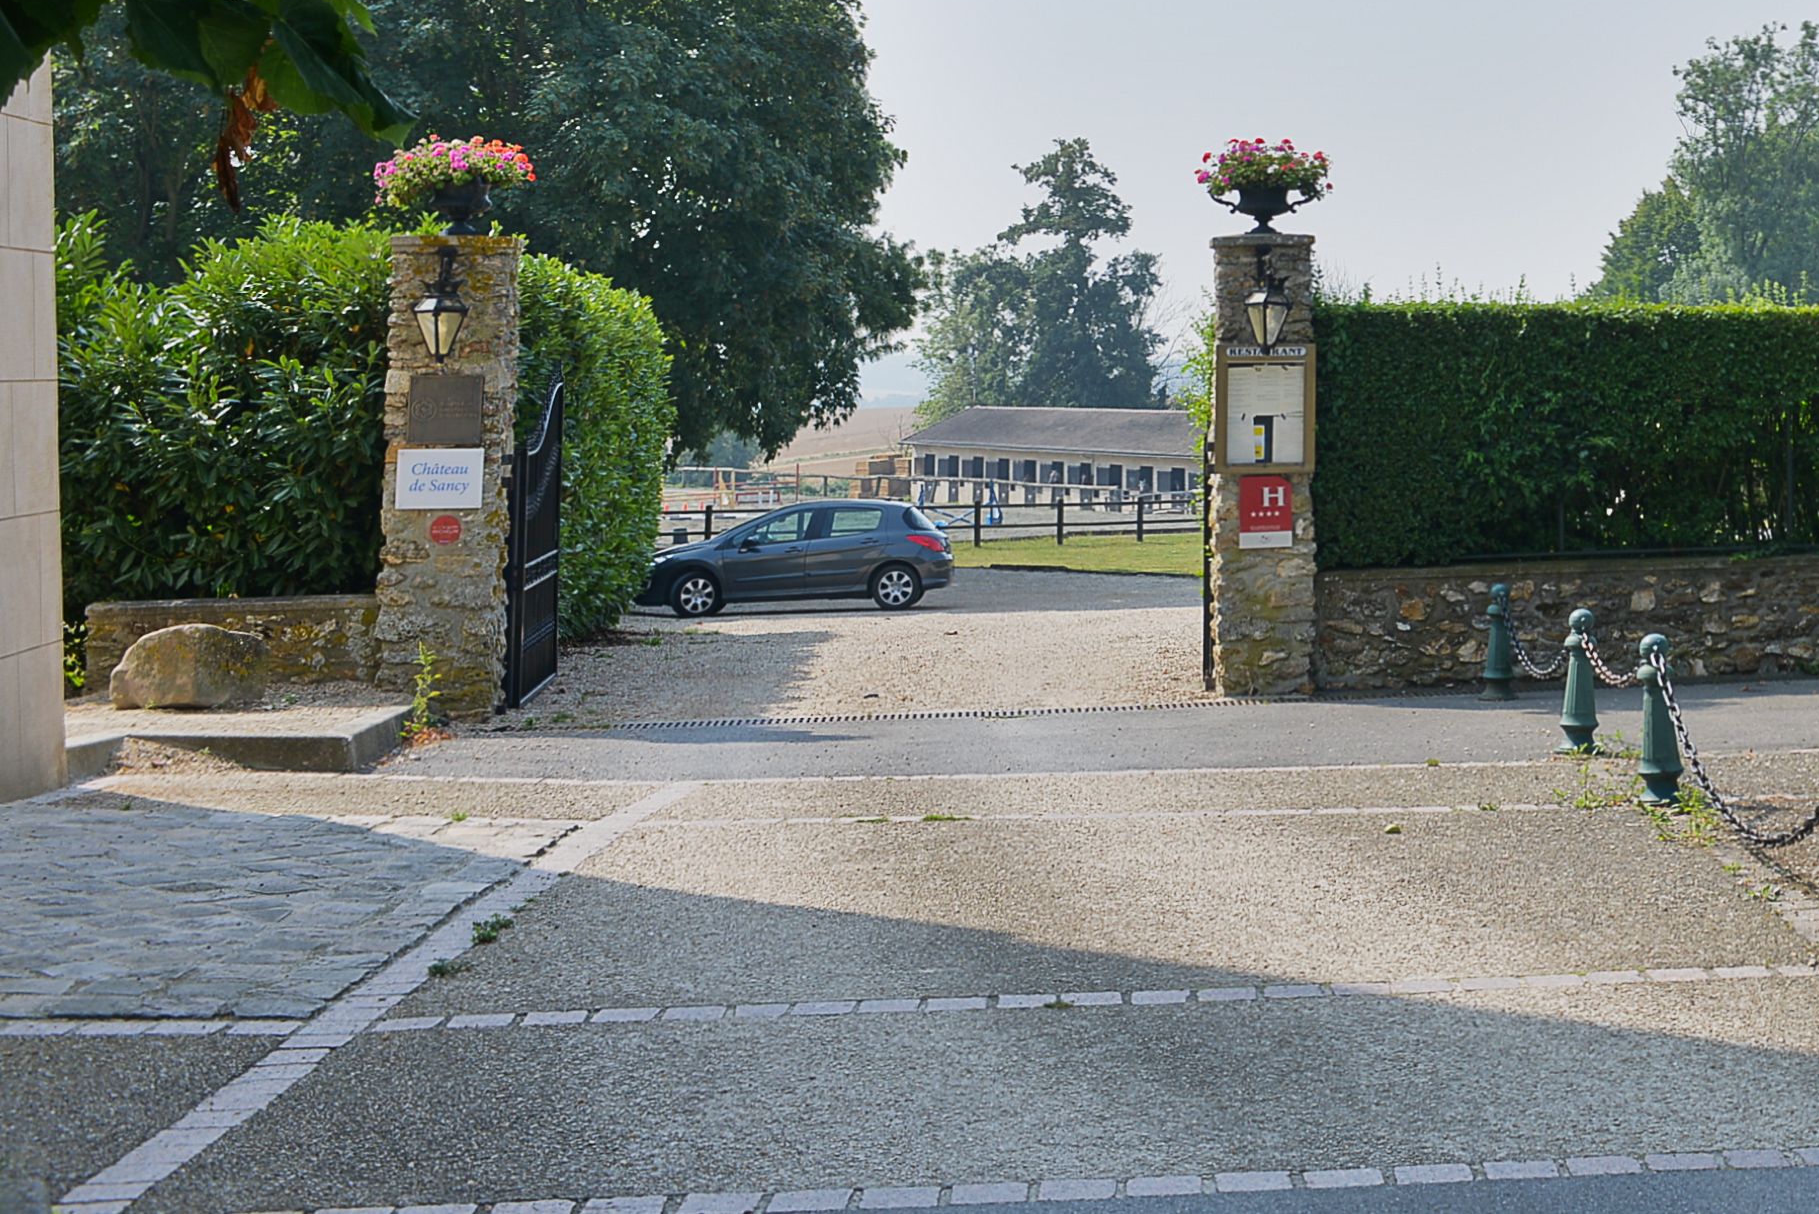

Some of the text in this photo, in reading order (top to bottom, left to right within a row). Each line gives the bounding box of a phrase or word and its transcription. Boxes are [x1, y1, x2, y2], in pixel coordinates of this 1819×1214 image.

[1229, 347, 1303, 356] RESTARANT
[411, 461, 469, 475] Château
[409, 478, 470, 495] de Sancy
[1262, 486, 1285, 507] H
